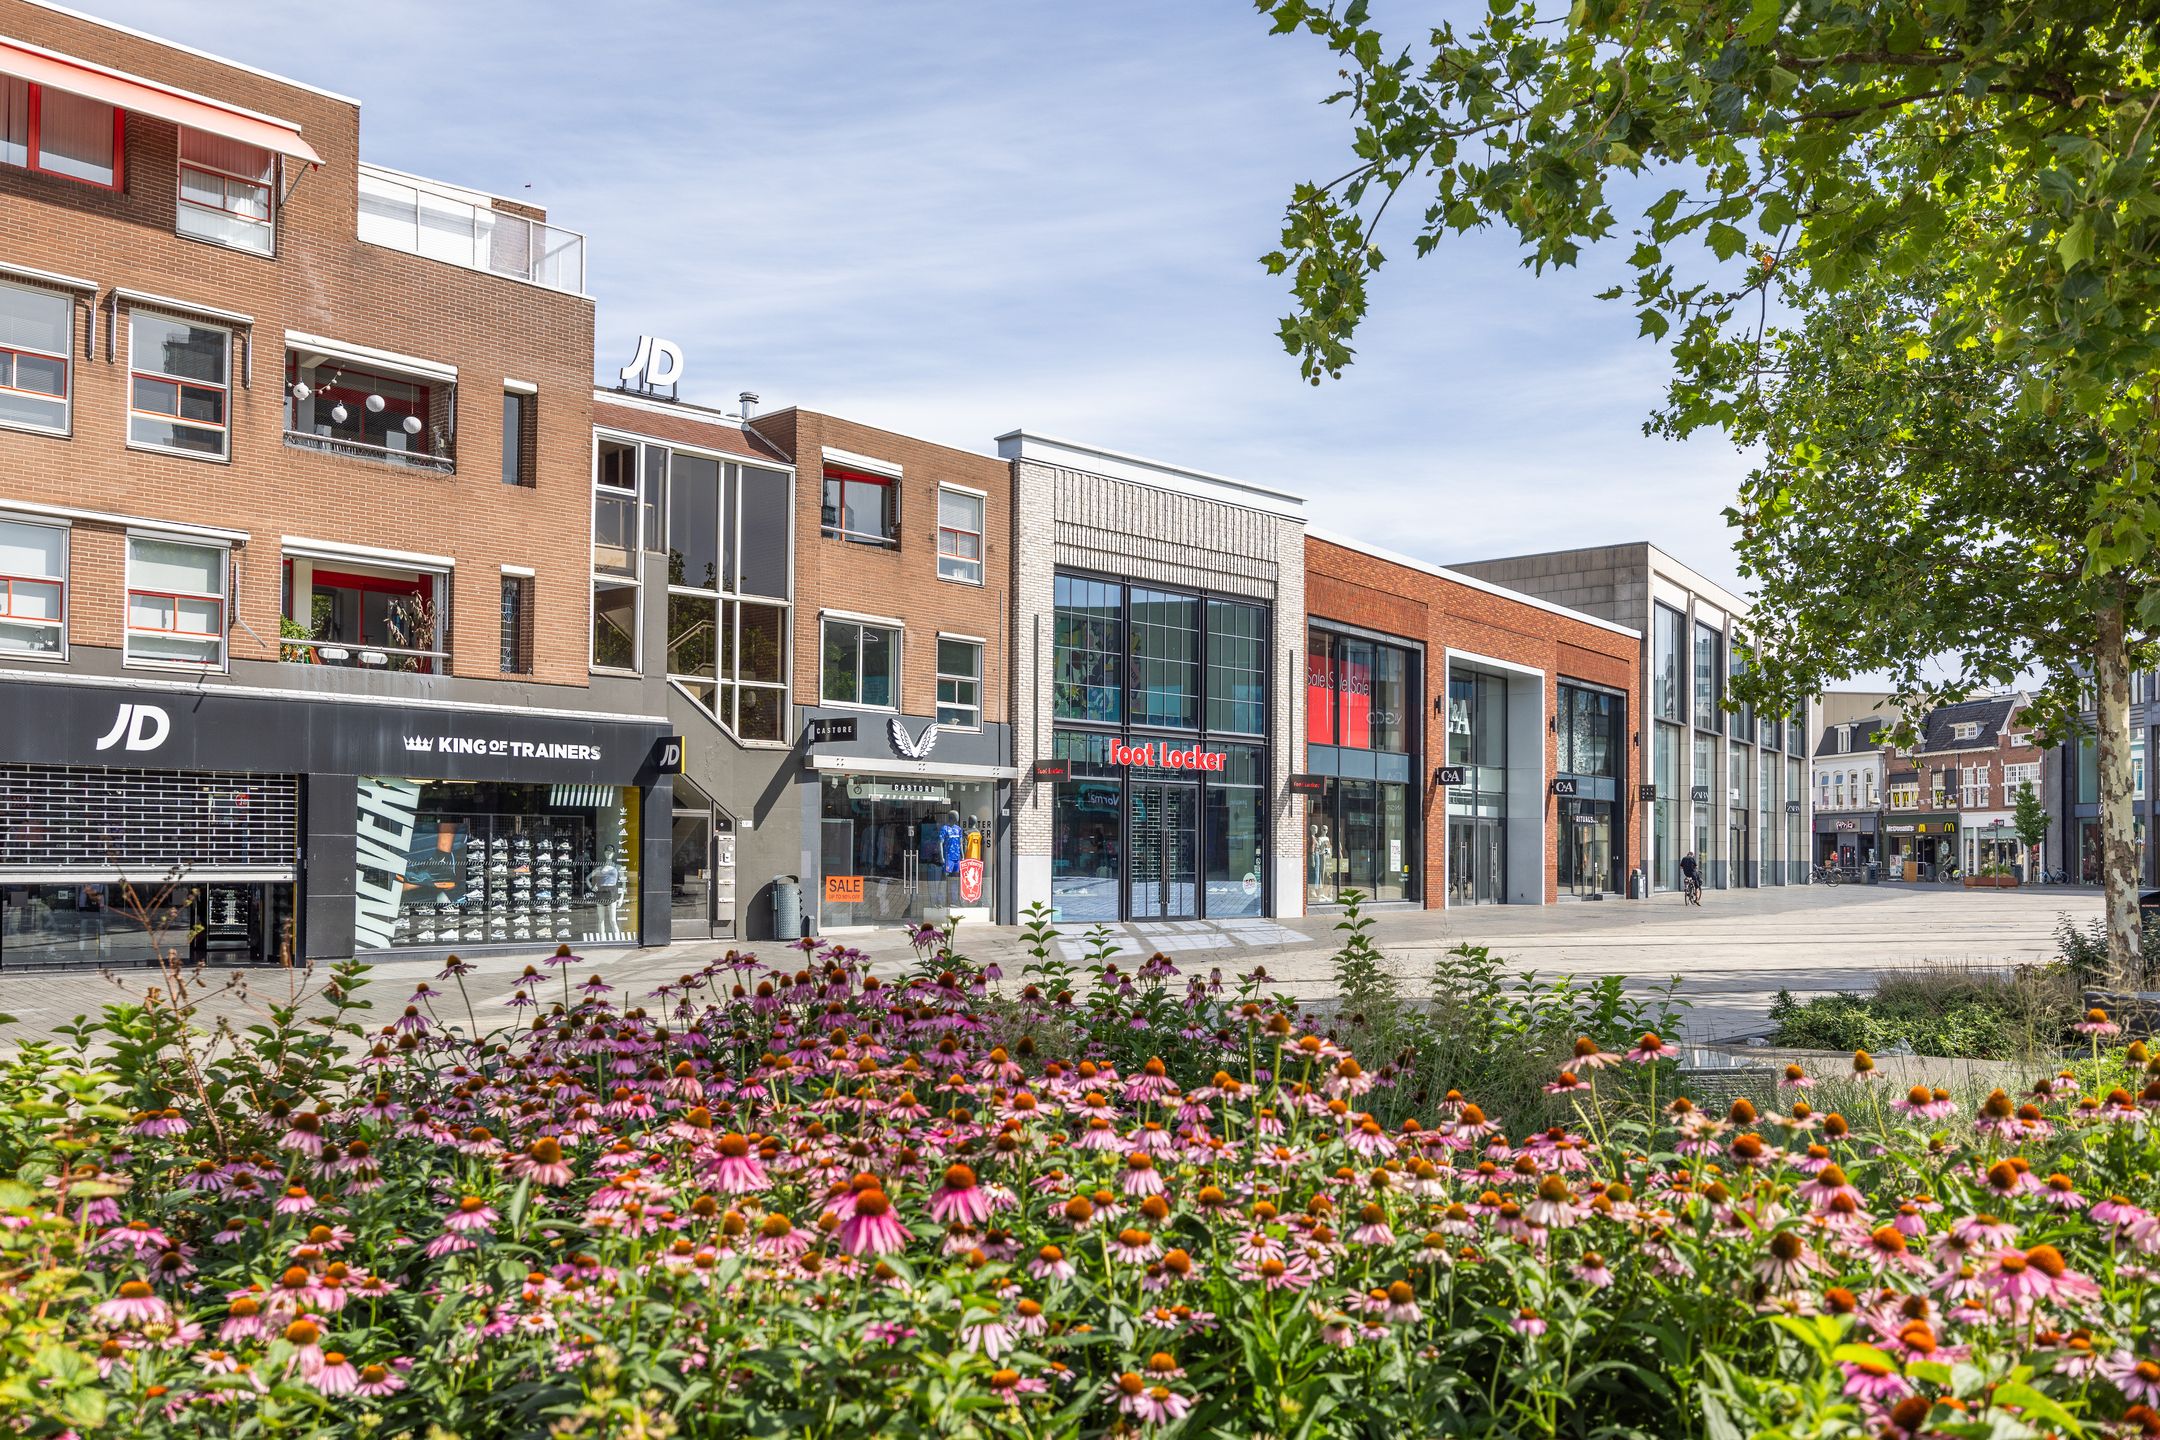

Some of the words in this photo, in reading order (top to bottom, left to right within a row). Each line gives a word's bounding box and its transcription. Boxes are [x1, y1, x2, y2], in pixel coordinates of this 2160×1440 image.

[620, 335, 684, 386] JD
[96, 704, 170, 751] JD
[816, 725, 852, 735] CASTORE
[439, 736, 486, 755] KING
[489, 740, 507, 755] OF
[510, 741, 601, 760] TRAINERS
[660, 744, 680, 766] JD
[1109, 738, 1155, 767] Foot
[1160, 741, 1227, 771] Locker
[1441, 770, 1460, 782] C&A
[894, 784, 935, 793] CASTORE
[1556, 781, 1574, 792] C&A
[829, 879, 861, 893] SALE
